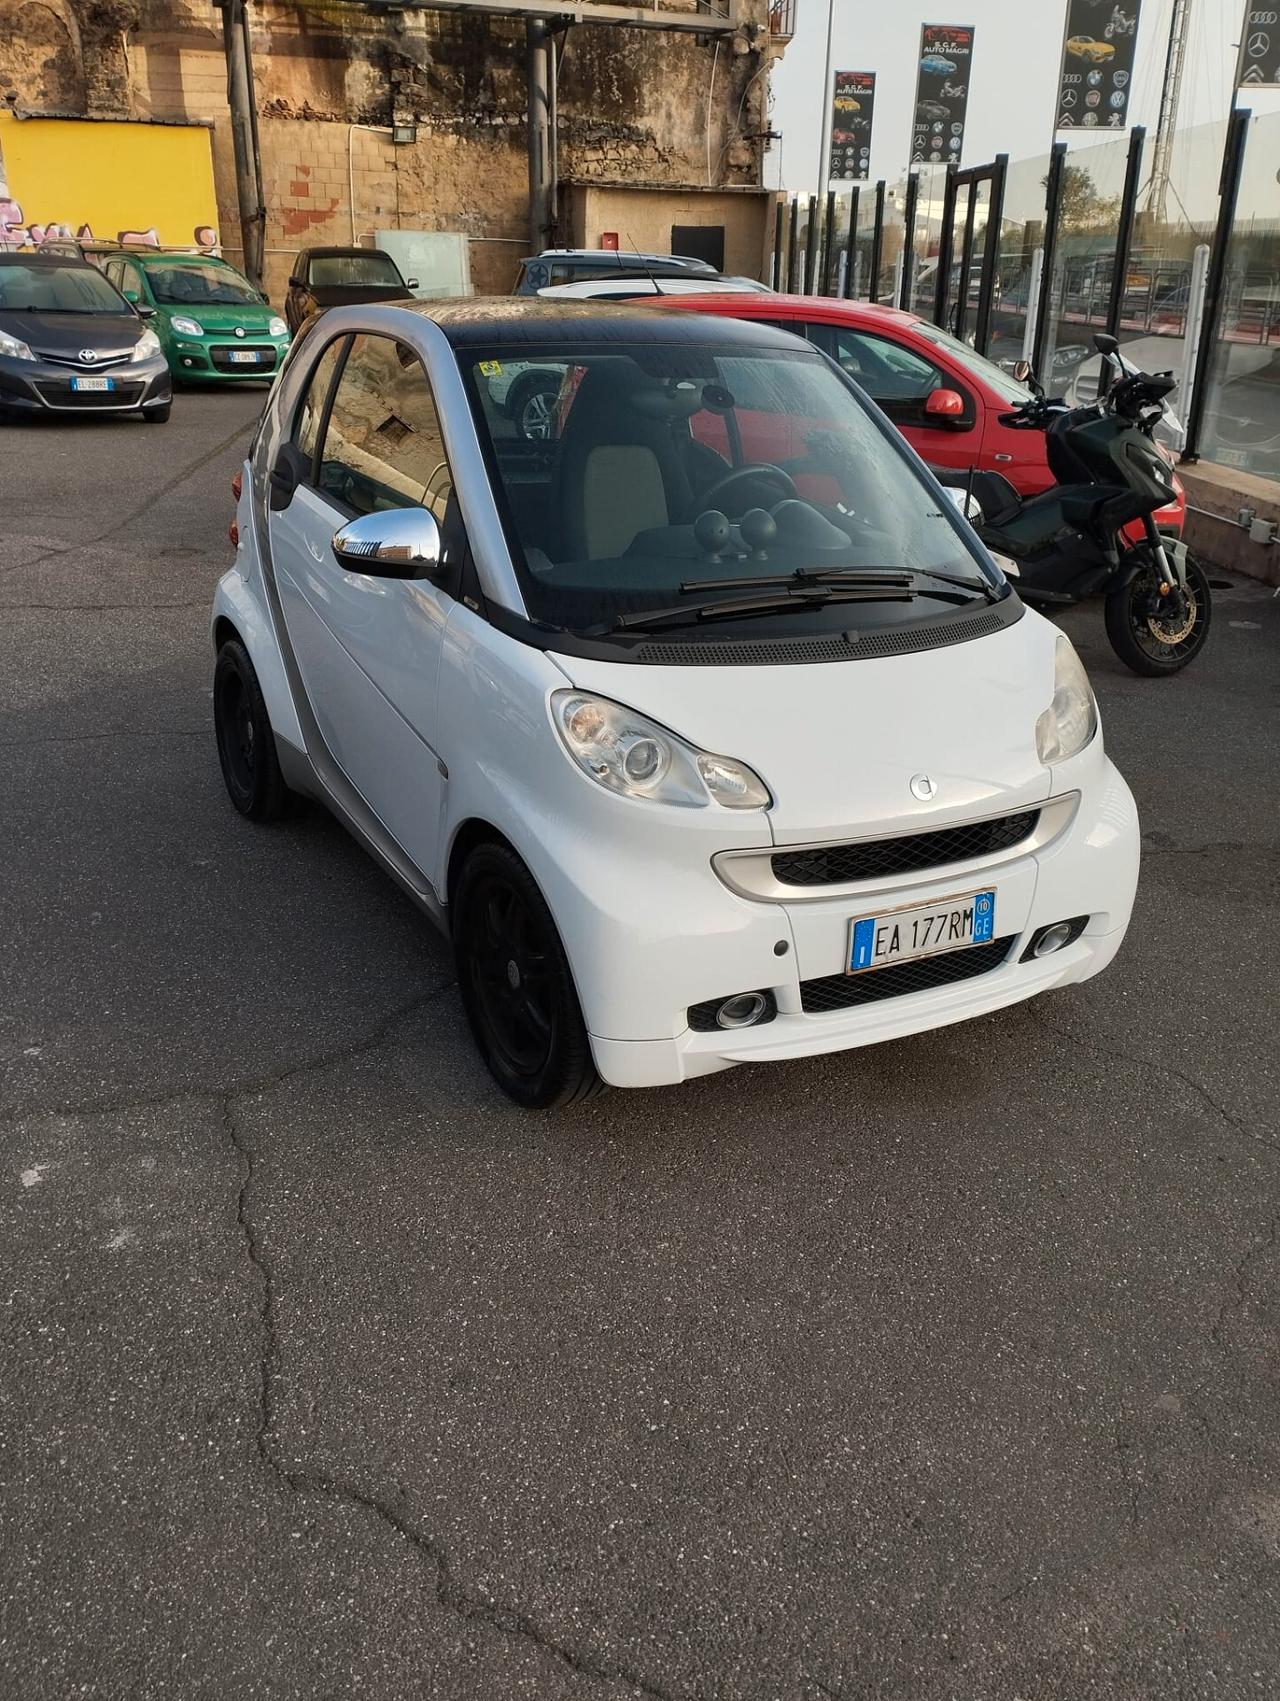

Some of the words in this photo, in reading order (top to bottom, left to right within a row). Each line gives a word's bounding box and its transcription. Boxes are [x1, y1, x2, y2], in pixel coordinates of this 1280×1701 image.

[979, 902, 988, 912] 10
[875, 924, 900, 956] EA
[912, 907, 974, 949] 177RM
[975, 917, 989, 936] GE
